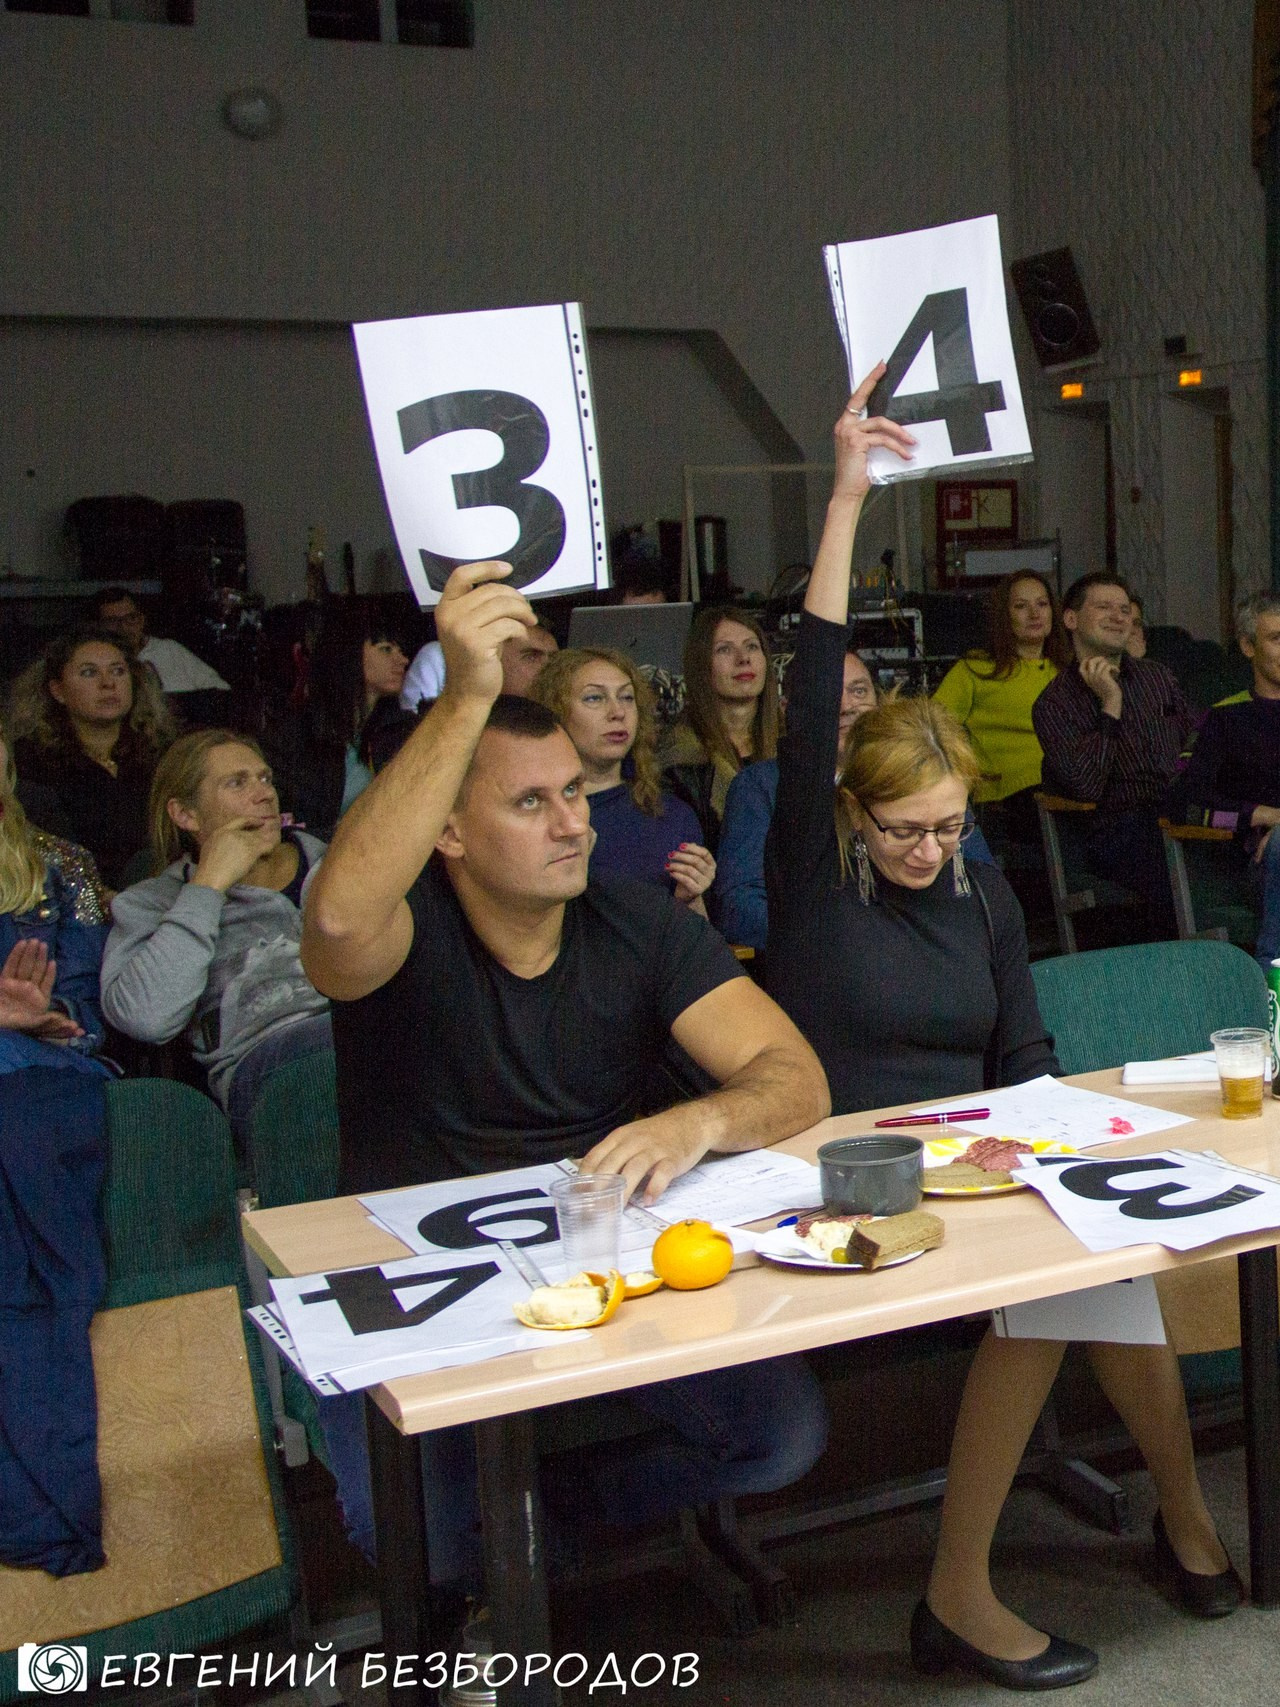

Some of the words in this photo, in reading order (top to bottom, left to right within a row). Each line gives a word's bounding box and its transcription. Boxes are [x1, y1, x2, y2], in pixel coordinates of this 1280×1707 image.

[868, 287, 1007, 456] 4
[396, 388, 568, 591] 3
[1059, 1158, 1265, 1220] 3
[299, 1261, 502, 1336] 4
